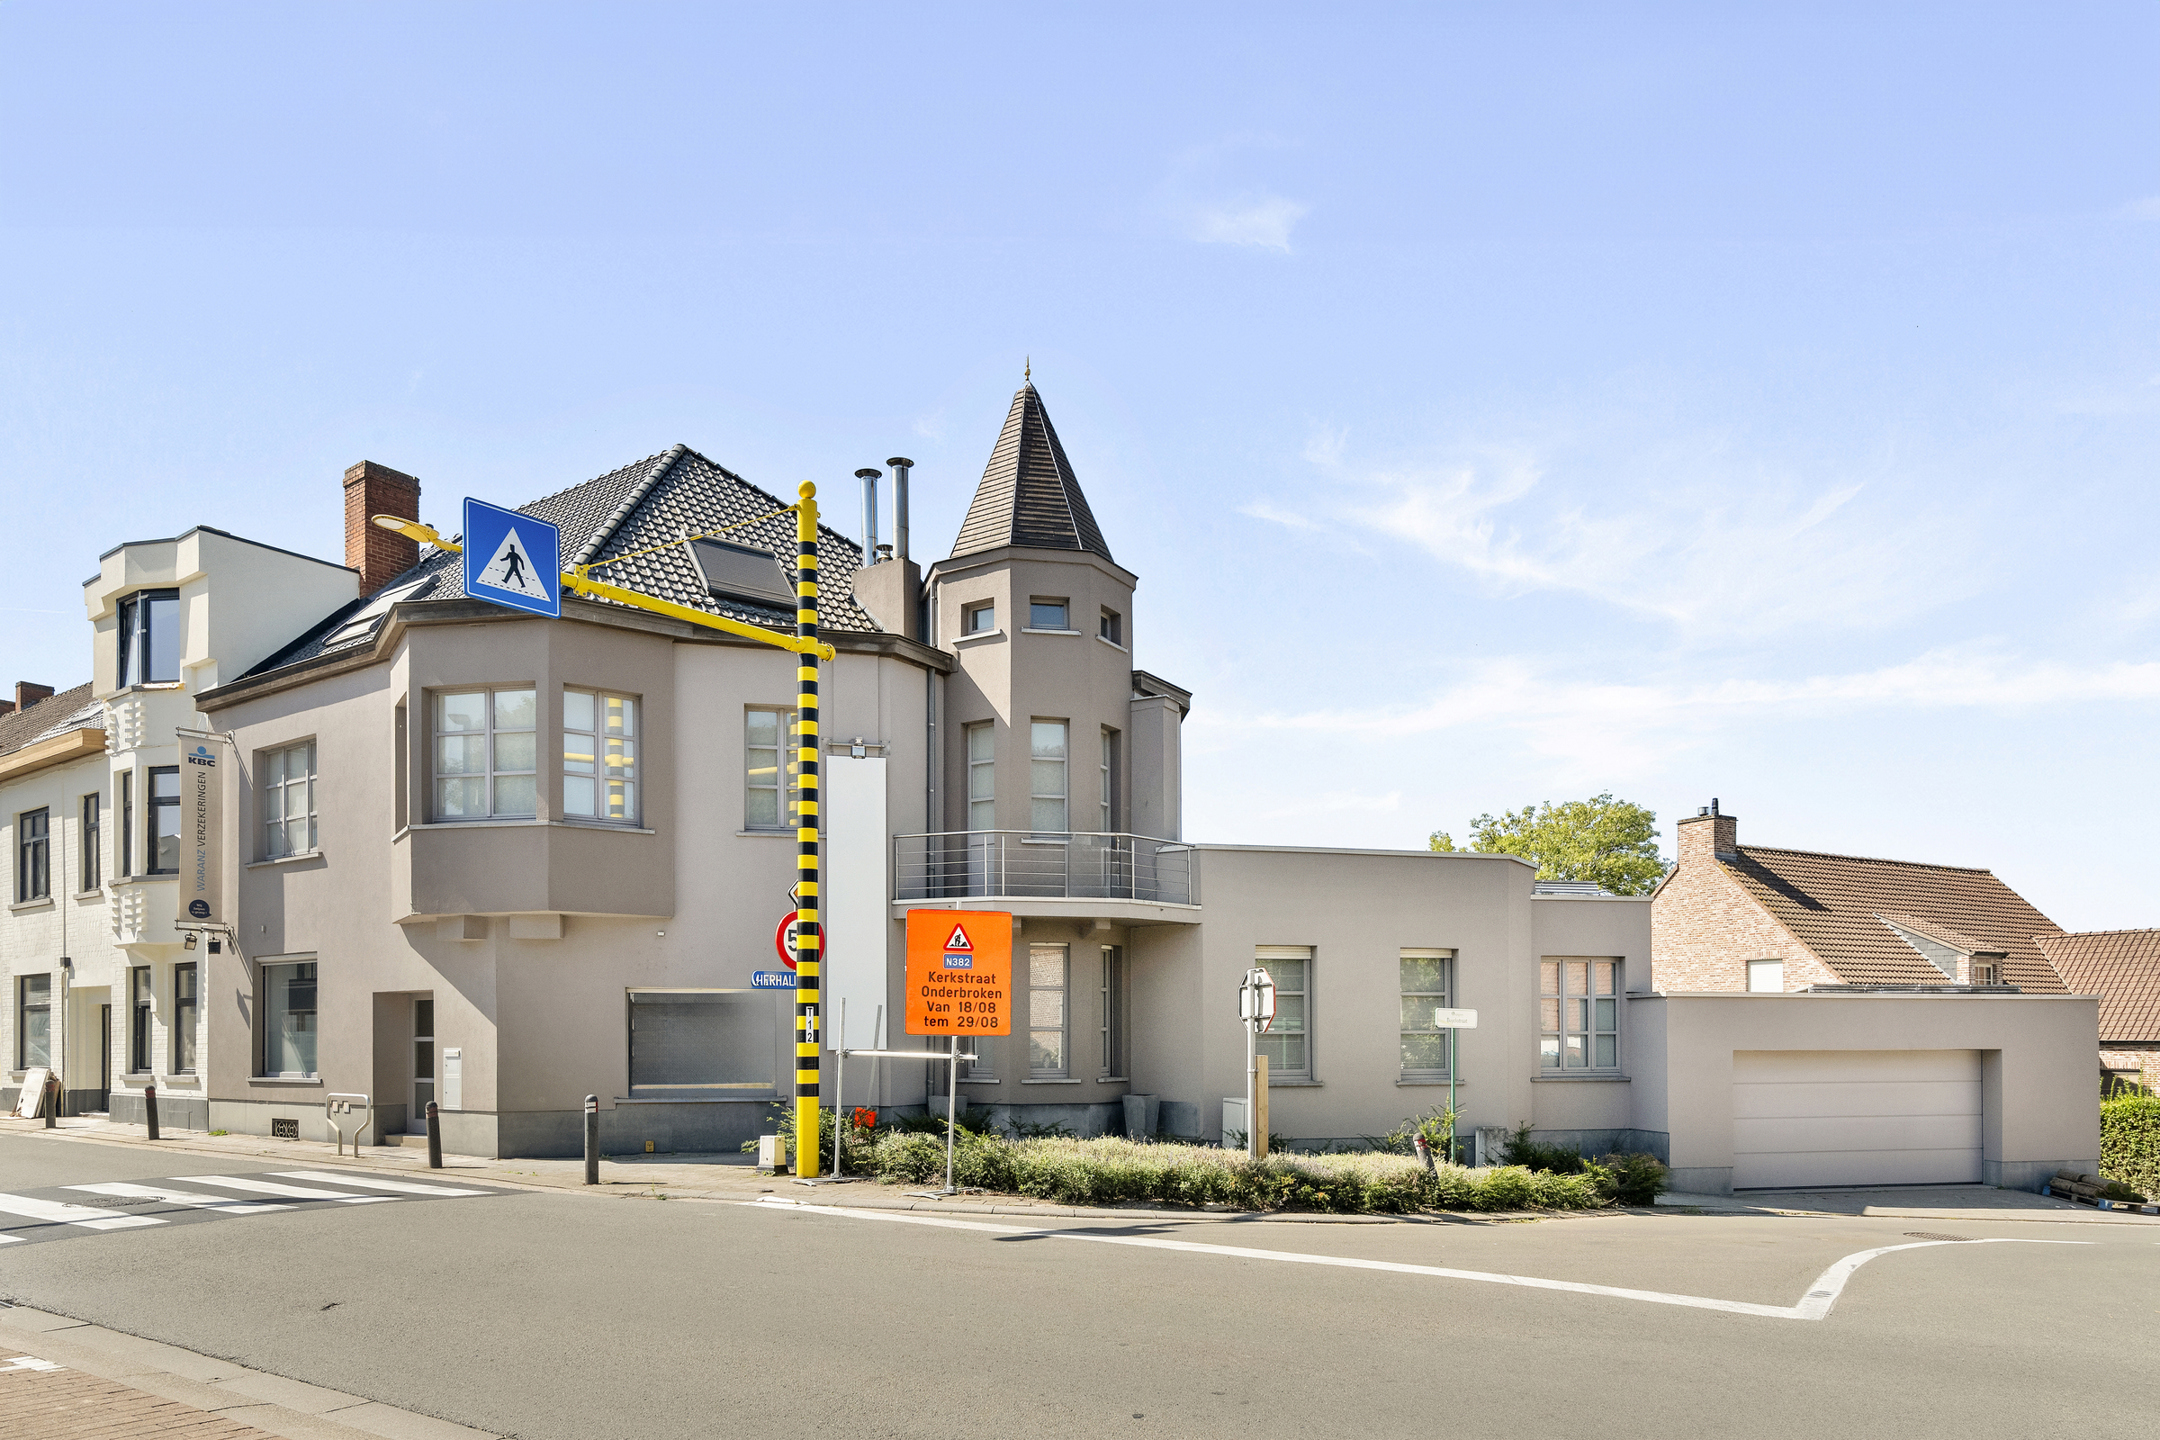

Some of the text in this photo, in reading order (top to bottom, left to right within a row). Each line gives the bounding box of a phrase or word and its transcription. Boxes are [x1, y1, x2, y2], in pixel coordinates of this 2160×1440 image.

[188, 756, 216, 768] KBC
[197, 771, 206, 892] WARANZ VERZEKERINGEN
[787, 929, 797, 952] 5
[946, 957, 970, 967] N382
[755, 974, 797, 987] HERHALI
[928, 971, 996, 985] Kerkstraat
[921, 985, 1002, 999] Onderbroken
[926, 1001, 996, 1013] Van 18/08
[924, 1016, 998, 1028] tem 29/08
